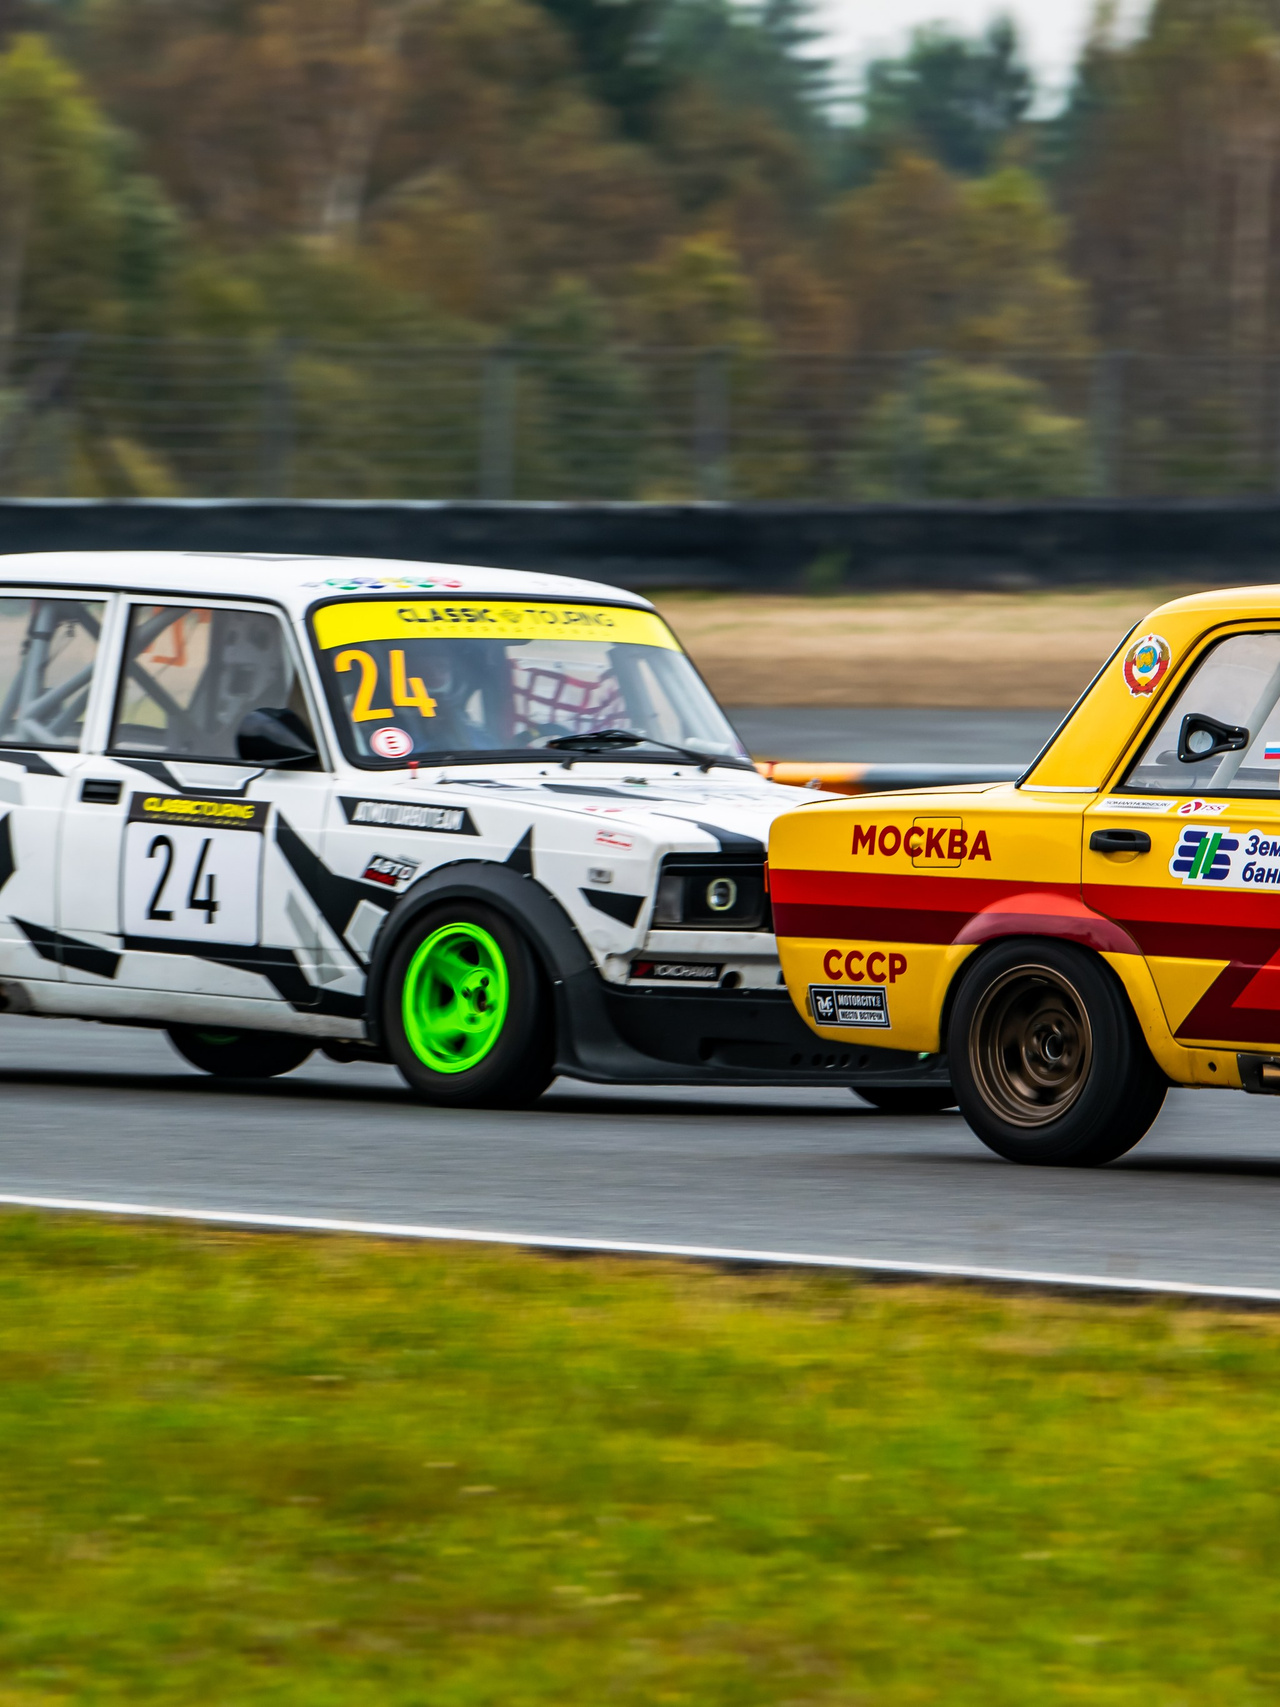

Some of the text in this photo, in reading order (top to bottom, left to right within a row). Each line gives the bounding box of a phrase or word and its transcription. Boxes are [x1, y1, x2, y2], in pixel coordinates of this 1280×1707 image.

[397, 608, 614, 628] CLASSIC TOURING
[334, 649, 438, 723] 24
[851, 824, 992, 862] МОСКВА
[145, 834, 220, 925] 24
[822, 948, 908, 984] СССР
